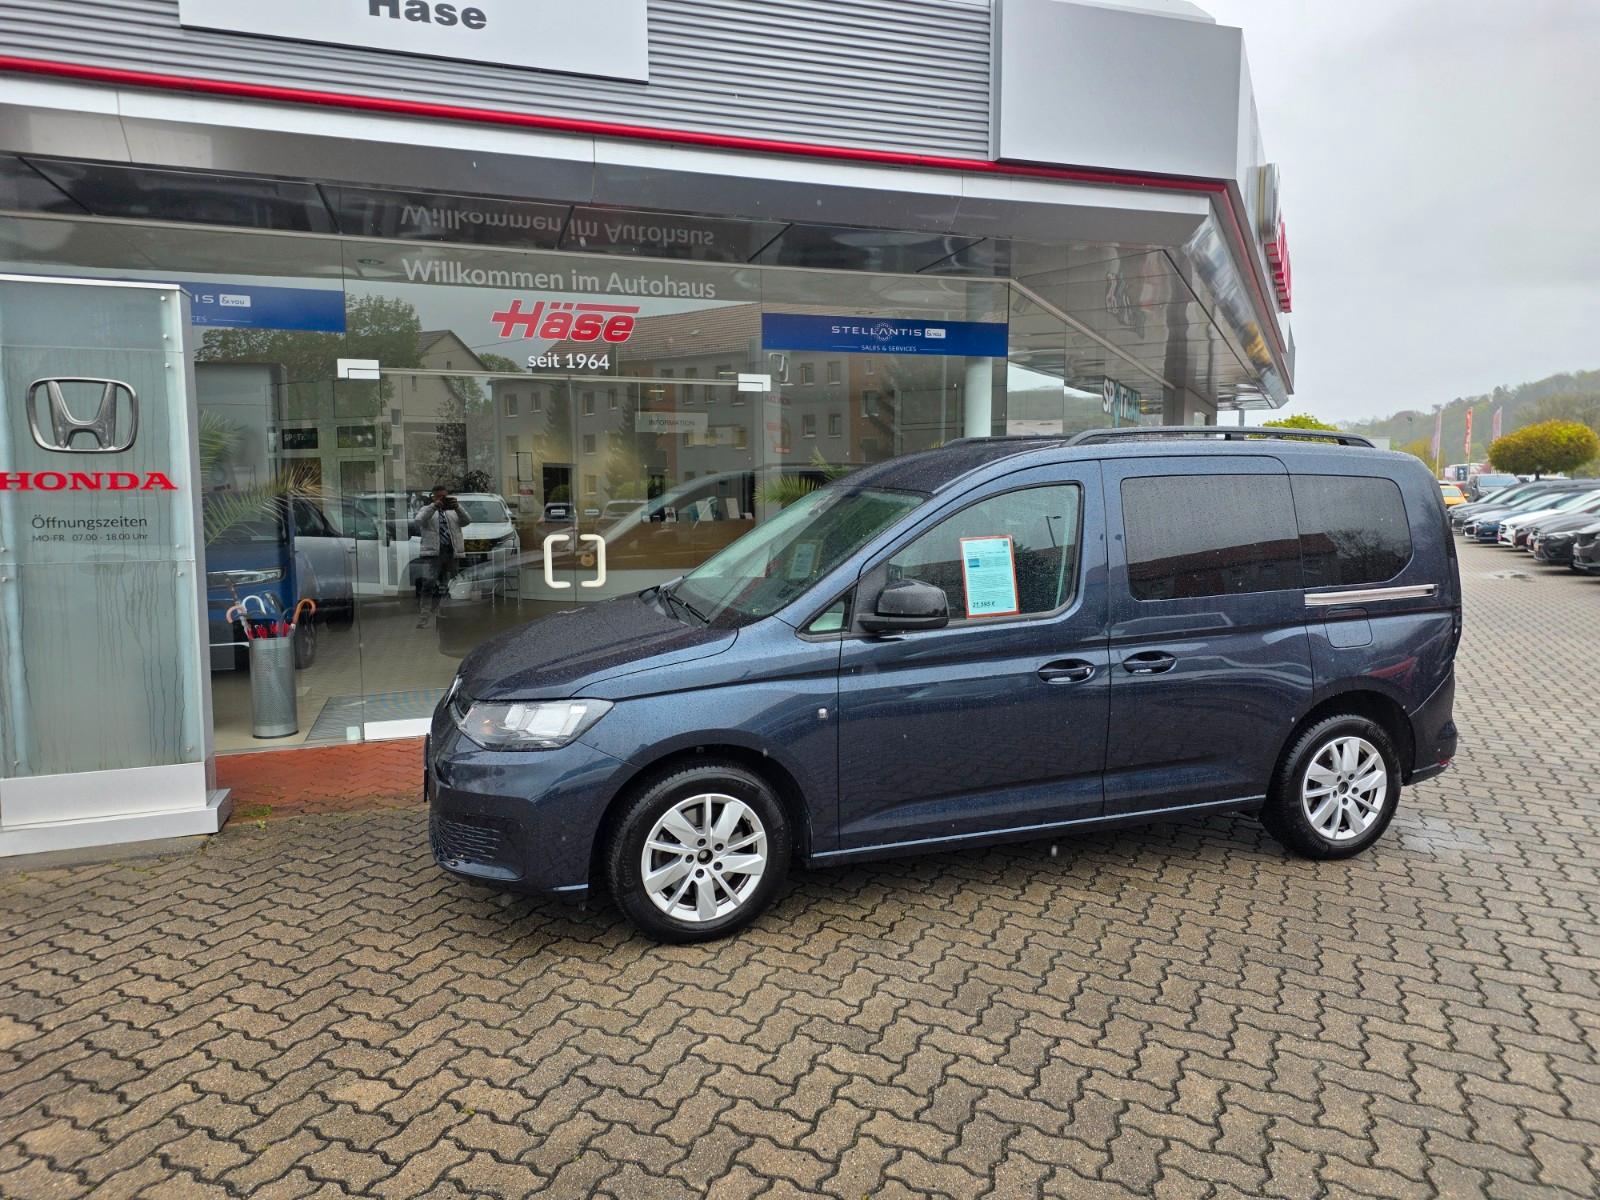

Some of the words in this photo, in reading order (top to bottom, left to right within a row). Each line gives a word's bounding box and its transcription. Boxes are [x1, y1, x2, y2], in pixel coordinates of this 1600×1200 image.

[401, 259, 563, 290] Willkommen
[571, 269, 600, 291] im
[606, 272, 716, 298] Autohaus
[491, 300, 640, 343] Häse
[831, 325, 922, 337] STELLANTIS
[528, 353, 560, 368] seit
[566, 354, 610, 370] 1964
[0, 472, 178, 491] HONDA
[31, 514, 147, 530] Öffnungszeiten
[132, 532, 148, 540] Uhr
